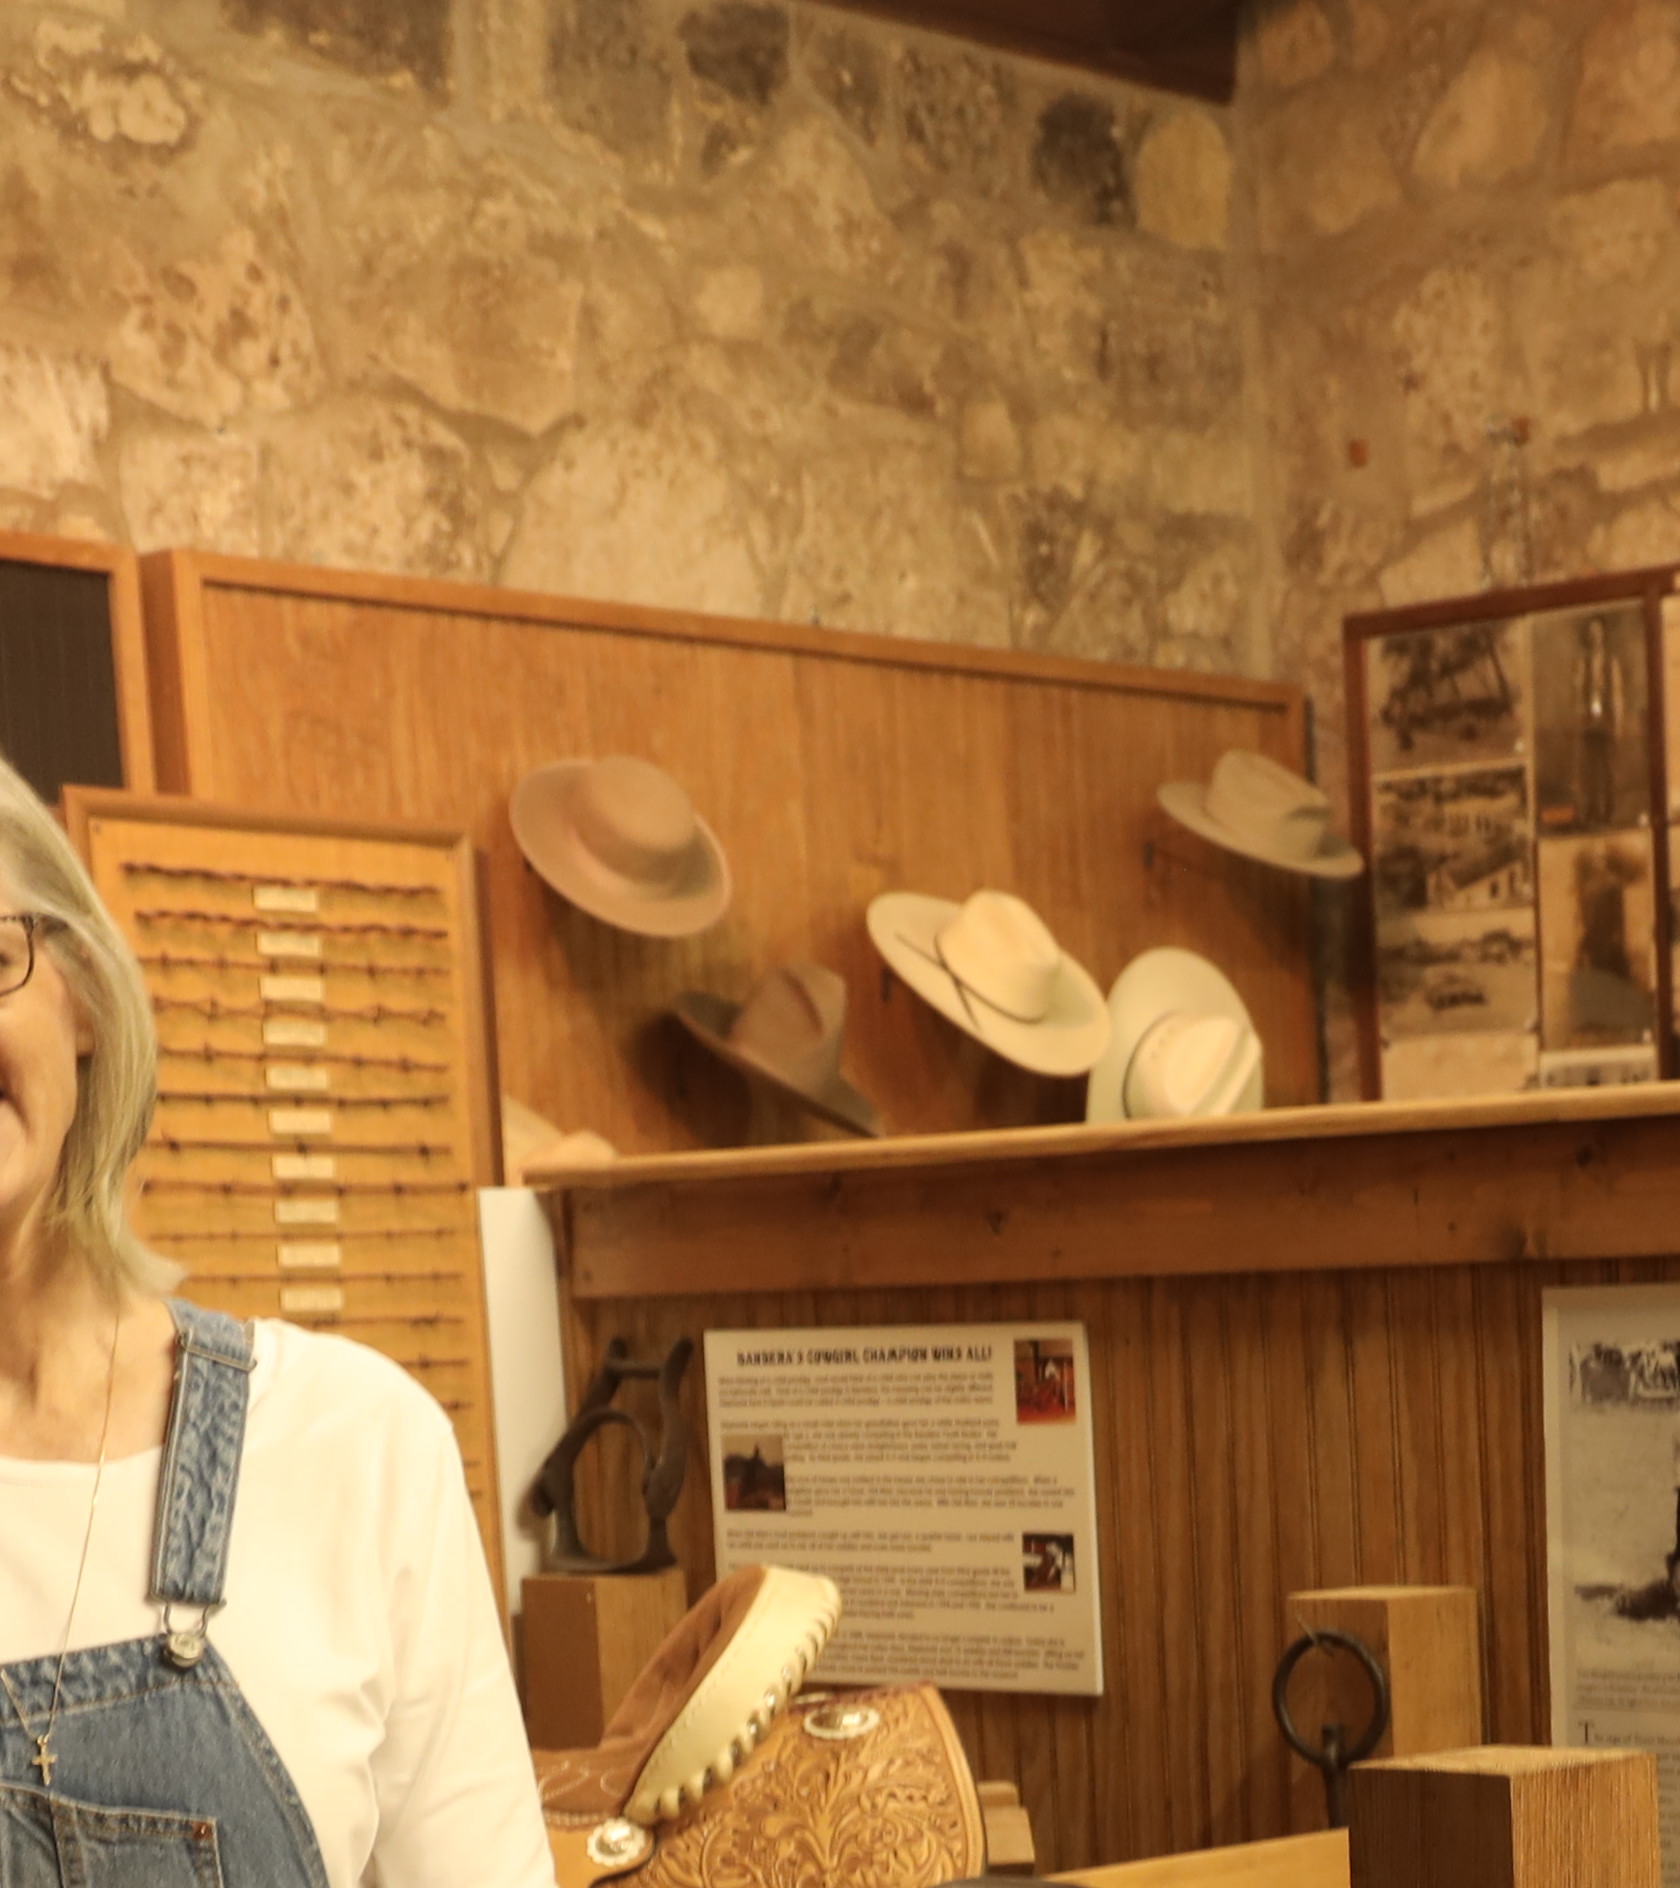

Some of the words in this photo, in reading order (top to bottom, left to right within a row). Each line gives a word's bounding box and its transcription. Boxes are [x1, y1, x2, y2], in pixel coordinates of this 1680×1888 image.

[807, 1348, 859, 1365] COWGIRL
[864, 1347, 926, 1364] CHAMPION
[932, 1346, 961, 1362] WINS
